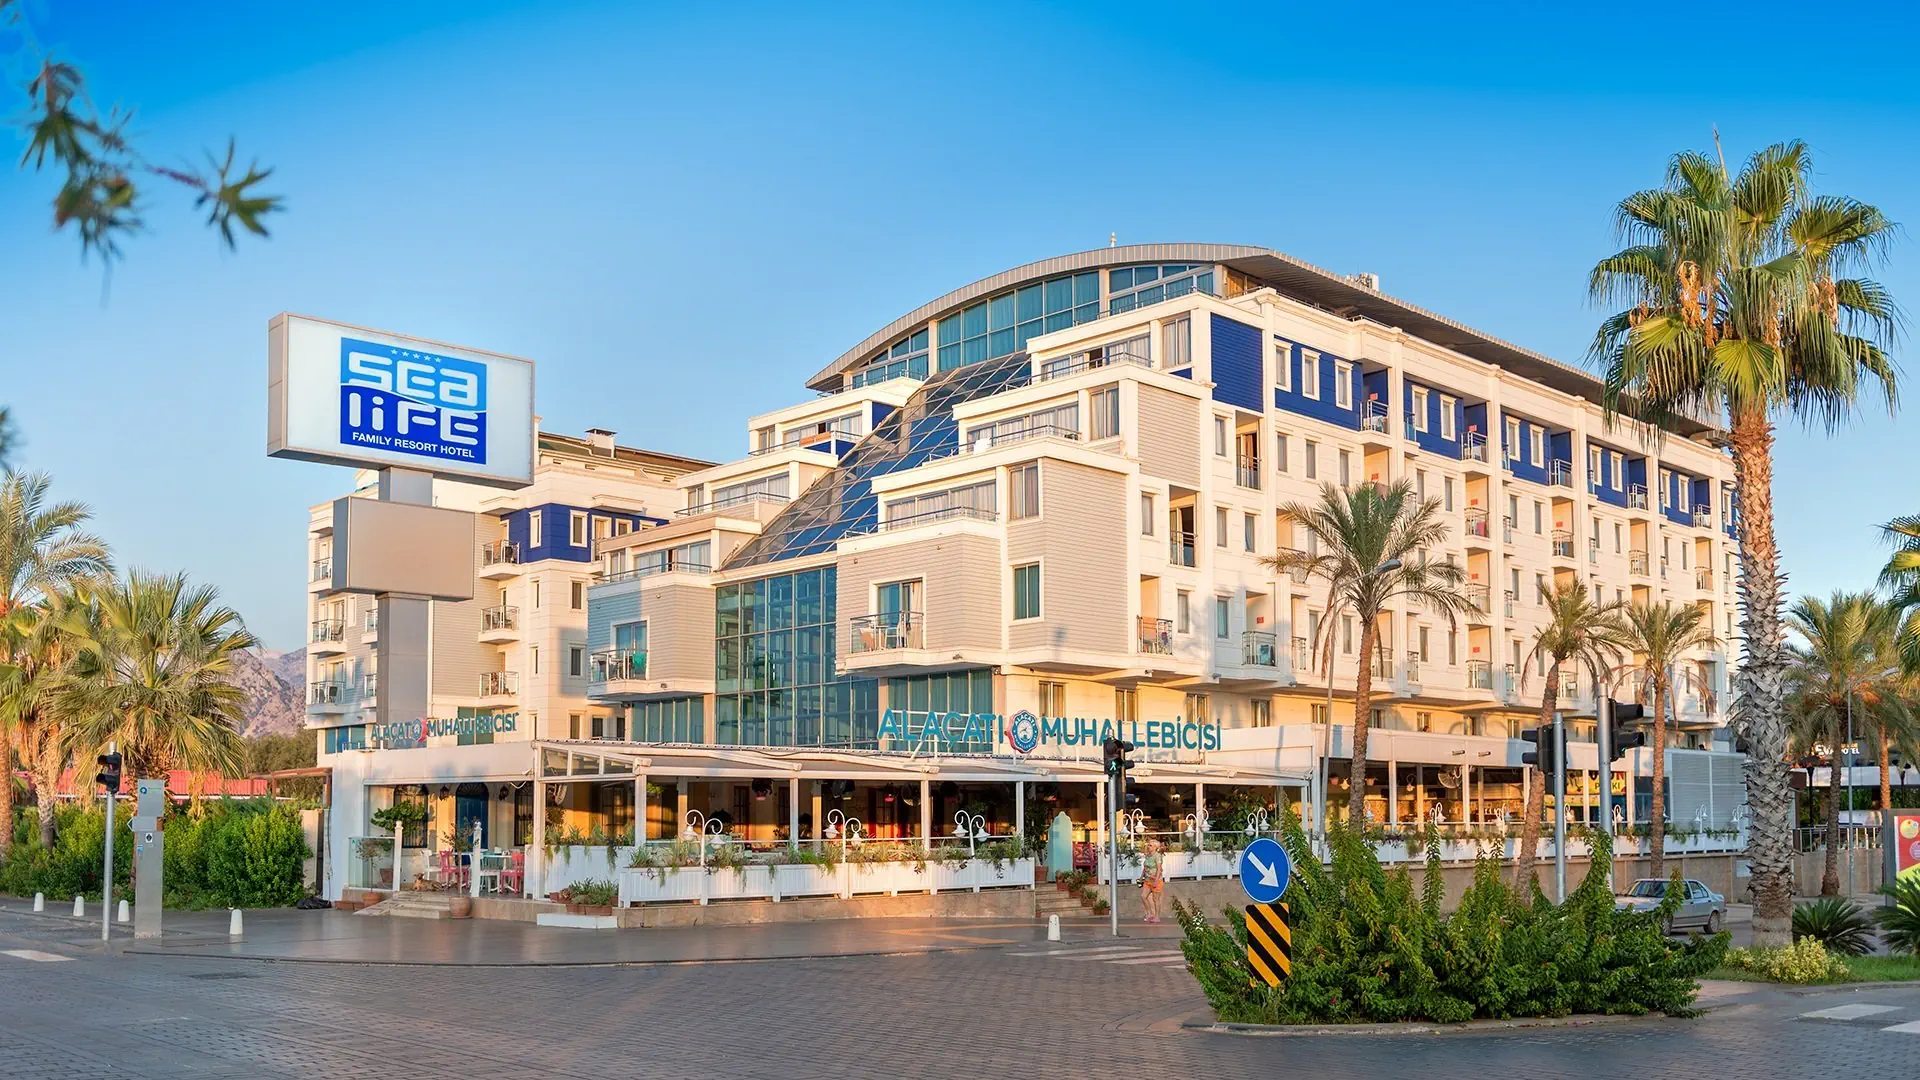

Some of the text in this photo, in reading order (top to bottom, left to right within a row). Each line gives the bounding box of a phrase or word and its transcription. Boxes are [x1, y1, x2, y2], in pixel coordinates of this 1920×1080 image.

[352, 431, 475, 458] FAMILY RESORT HOTEL
[371, 721, 413, 741] ALAÇAT
[877, 707, 1004, 749] ALAÇATI
